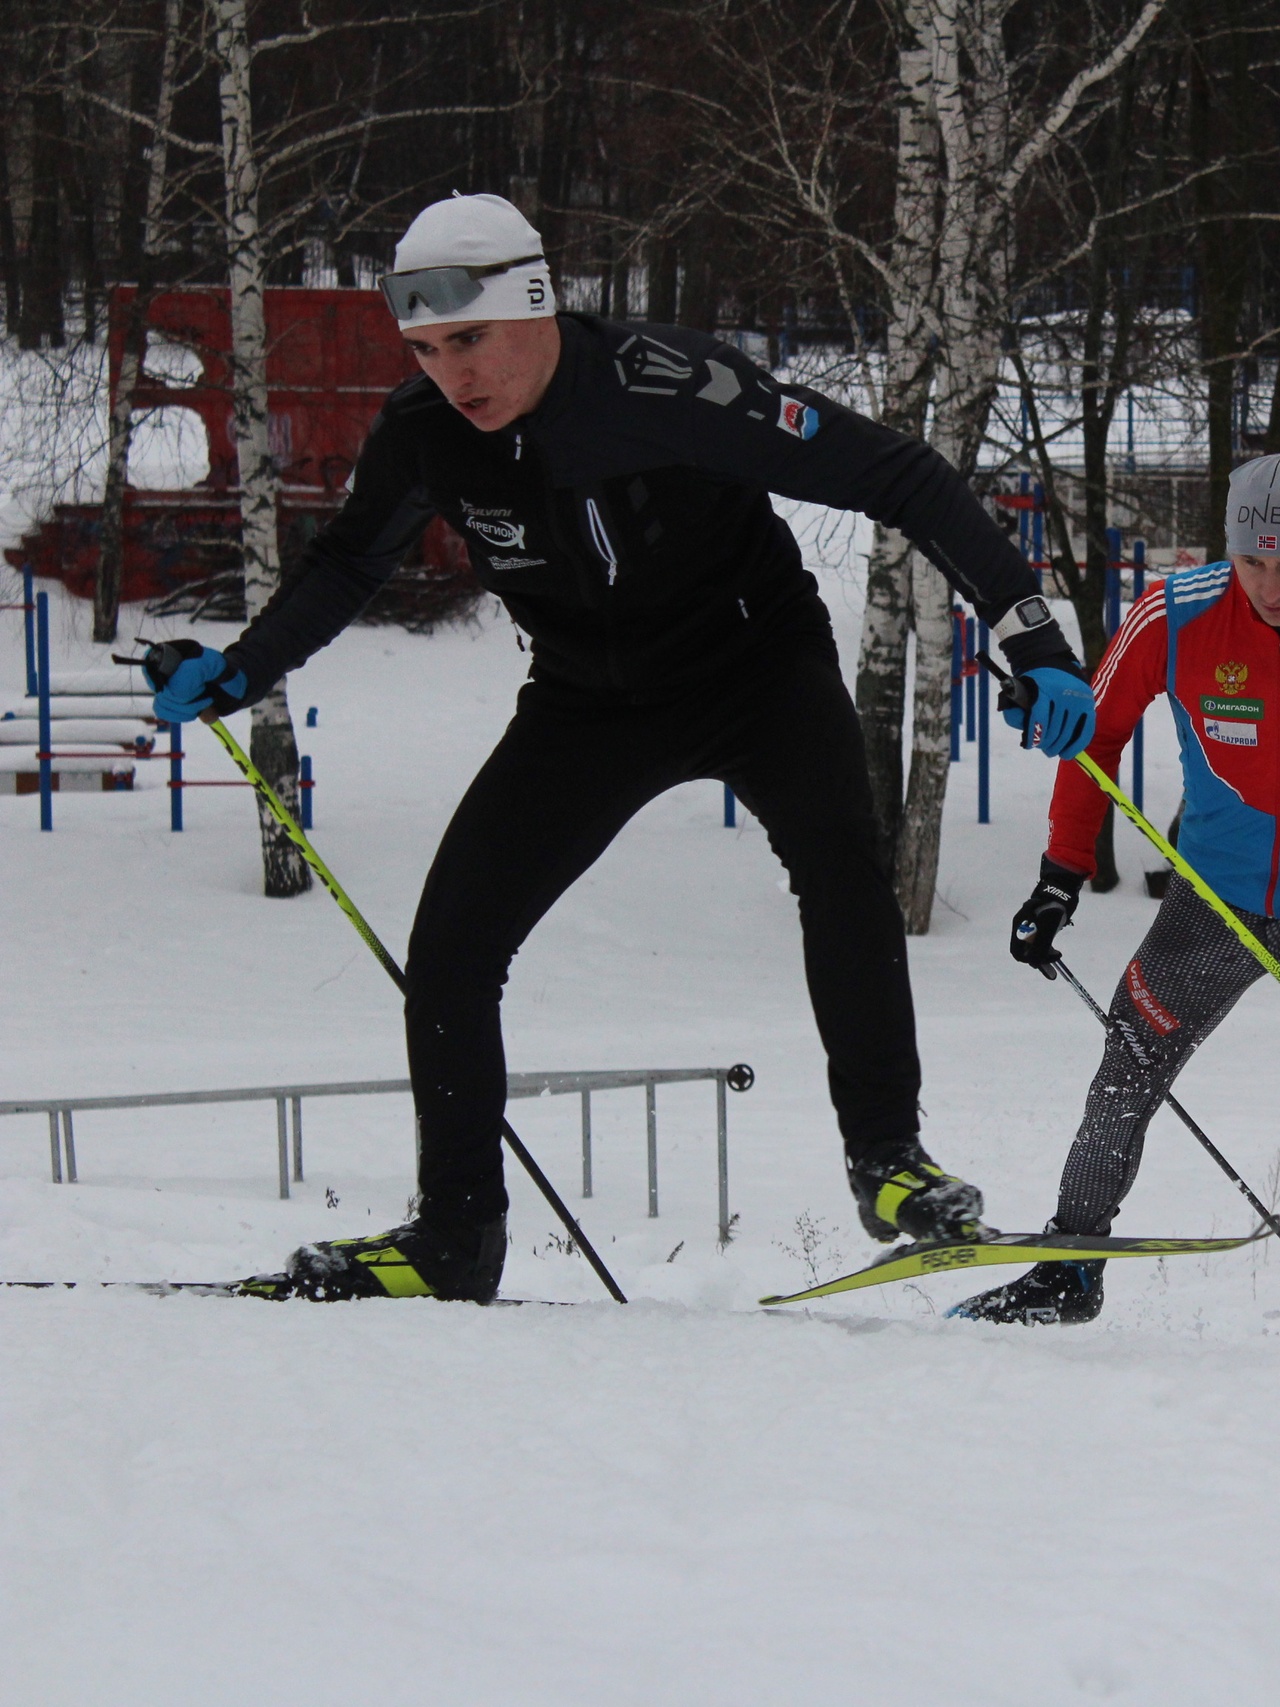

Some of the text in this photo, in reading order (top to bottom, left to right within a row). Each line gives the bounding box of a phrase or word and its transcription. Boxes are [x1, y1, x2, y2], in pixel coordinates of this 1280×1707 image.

[468, 508, 512, 517] SILVINI
[1221, 735, 1257, 747] GAZPROM
[1043, 884, 1072, 902] SWIX
[1129, 963, 1175, 1031] VIESSMANN
[921, 1247, 977, 1267] FISCHER
